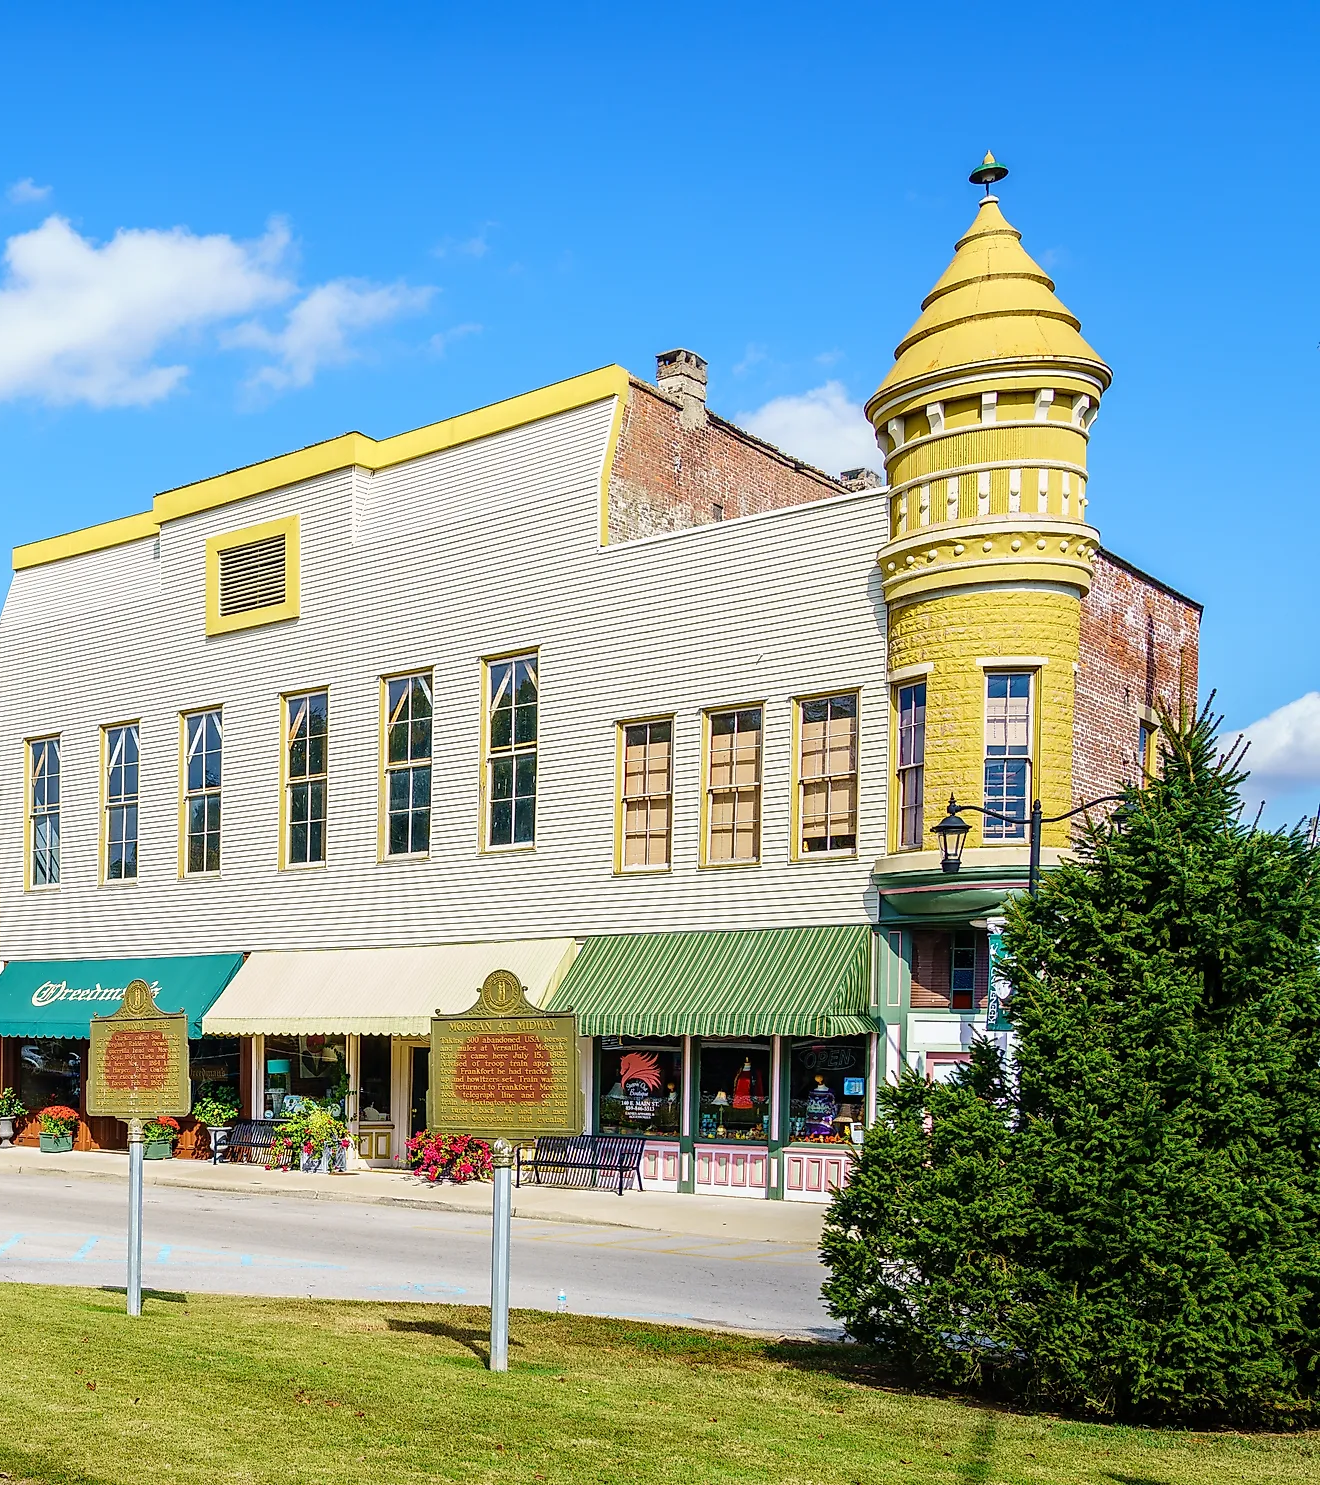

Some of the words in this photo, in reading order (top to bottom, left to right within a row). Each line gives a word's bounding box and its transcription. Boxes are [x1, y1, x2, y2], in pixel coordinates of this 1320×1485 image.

[448, 1021, 492, 1033] MORGAN
[498, 1021, 511, 1031] AT
[516, 1019, 557, 1031] MIDWAY
[482, 1036, 521, 1044] abandoned
[524, 1036, 540, 1044] USA
[543, 1036, 568, 1044] horses
[439, 1044, 453, 1052] and
[457, 1044, 477, 1052] mules
[480, 1044, 488, 1052] at
[492, 1051, 509, 1060] here
[512, 1051, 529, 1061] July
[804, 1048, 852, 1069] OPEN
[471, 1059, 480, 1067] of
[485, 1060, 505, 1068] troop
[509, 1059, 528, 1067] train
[532, 1060, 568, 1068] approach
[190, 1067, 226, 1077] reedman's
[439, 1067, 458, 1075] from
[460, 1067, 496, 1075] Frankfort
[497, 1067, 505, 1075] he
[508, 1067, 522, 1075] had
[524, 1067, 548, 1075] tracks
[440, 1076, 449, 1084] up
[452, 1075, 464, 1083] and
[466, 1075, 500, 1083] howitzers
[501, 1075, 515, 1083] set.
[518, 1075, 538, 1083] Train
[440, 1083, 453, 1091] and
[455, 1083, 486, 1091] returned
[488, 1083, 496, 1091] to
[497, 1083, 535, 1091] Frankfort.
[539, 1083, 568, 1092] Morgan
[440, 1091, 457, 1099] took
[462, 1091, 495, 1100] telegraph
[501, 1091, 515, 1099] line
[521, 1091, 535, 1099] and
[471, 1100, 506, 1108] Lexington
[450, 1107, 475, 1115] turned
[518, 1107, 533, 1115] and
[471, 1115, 513, 1124] Georgetown
